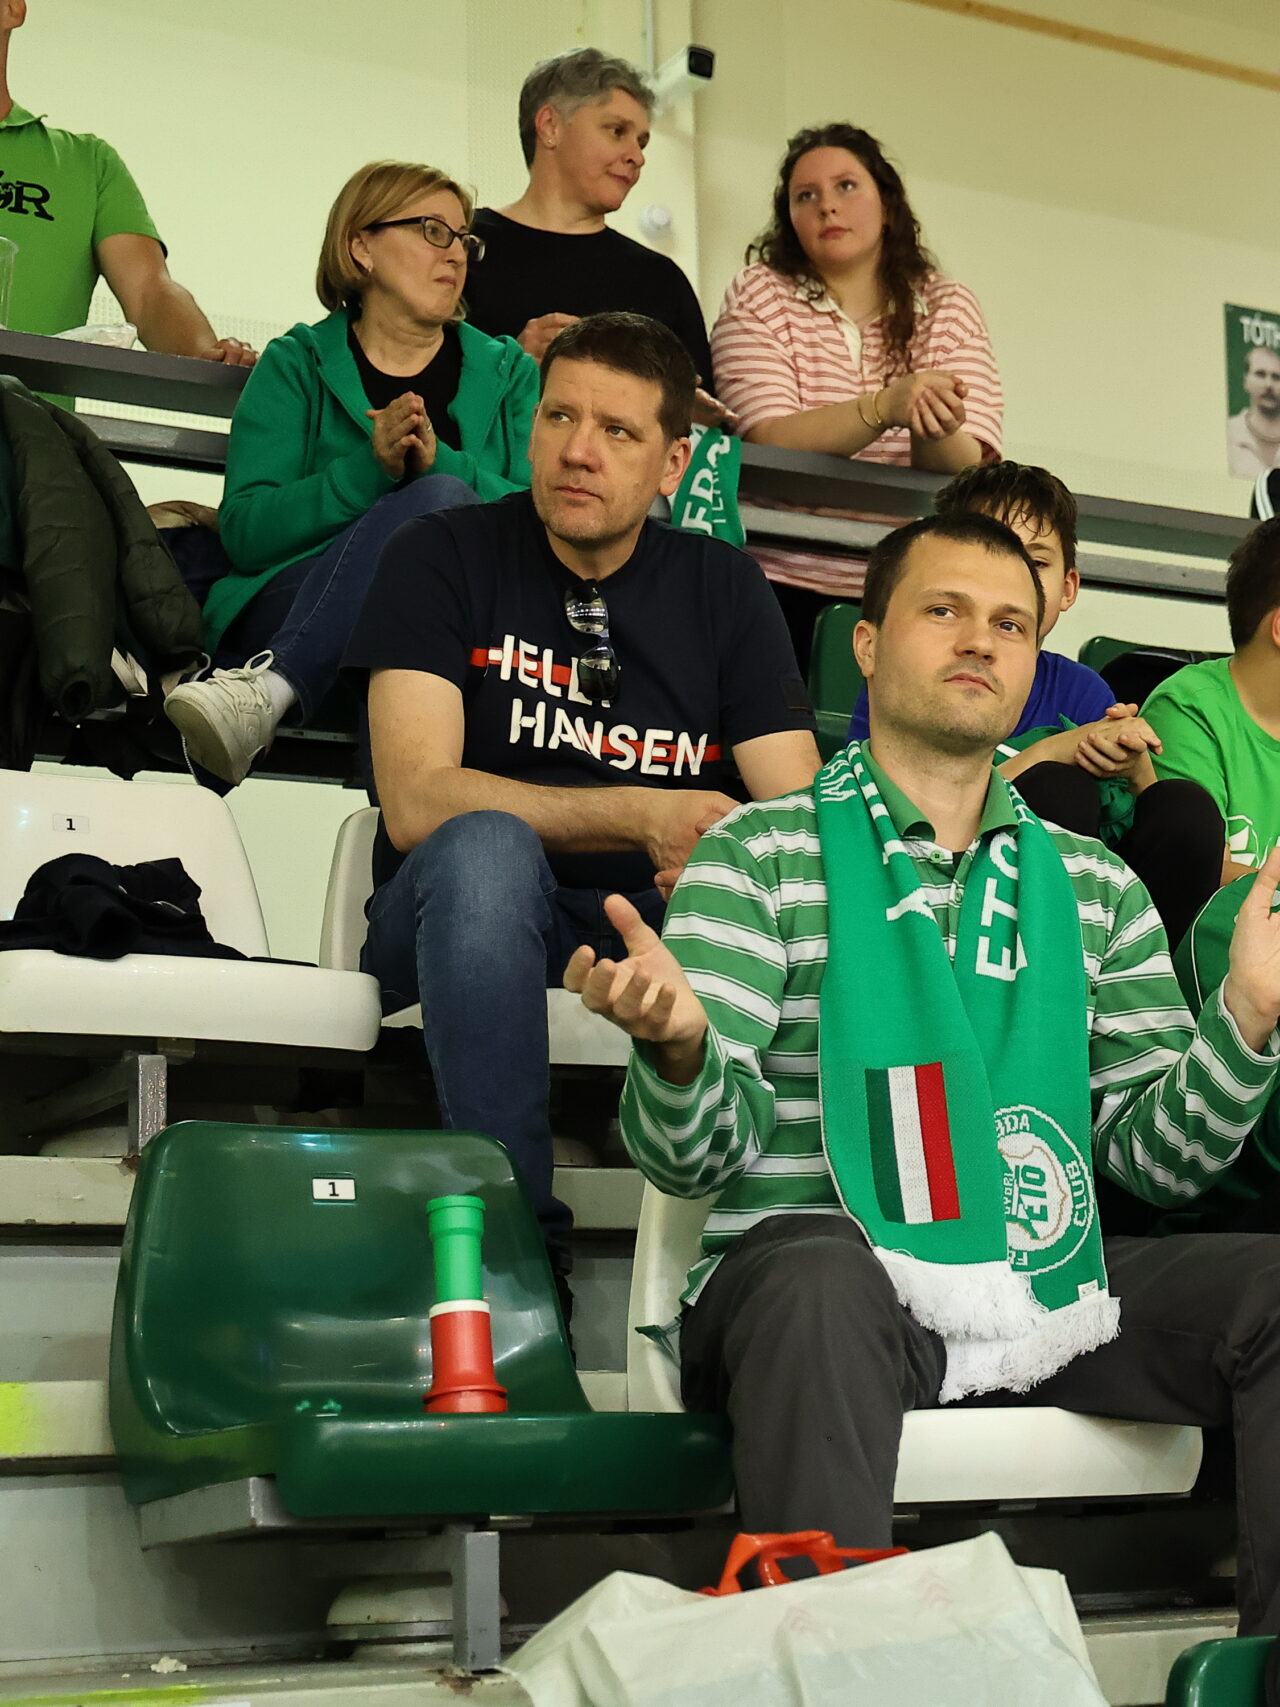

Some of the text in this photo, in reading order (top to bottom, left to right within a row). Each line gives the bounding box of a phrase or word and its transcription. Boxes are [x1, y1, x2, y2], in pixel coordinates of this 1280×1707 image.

[488, 634, 620, 708] HELL
[509, 698, 708, 777] HANSEN
[66, 818, 76, 831] 1
[328, 1181, 340, 1197] 1
[1065, 1160, 1088, 1227] CLUB
